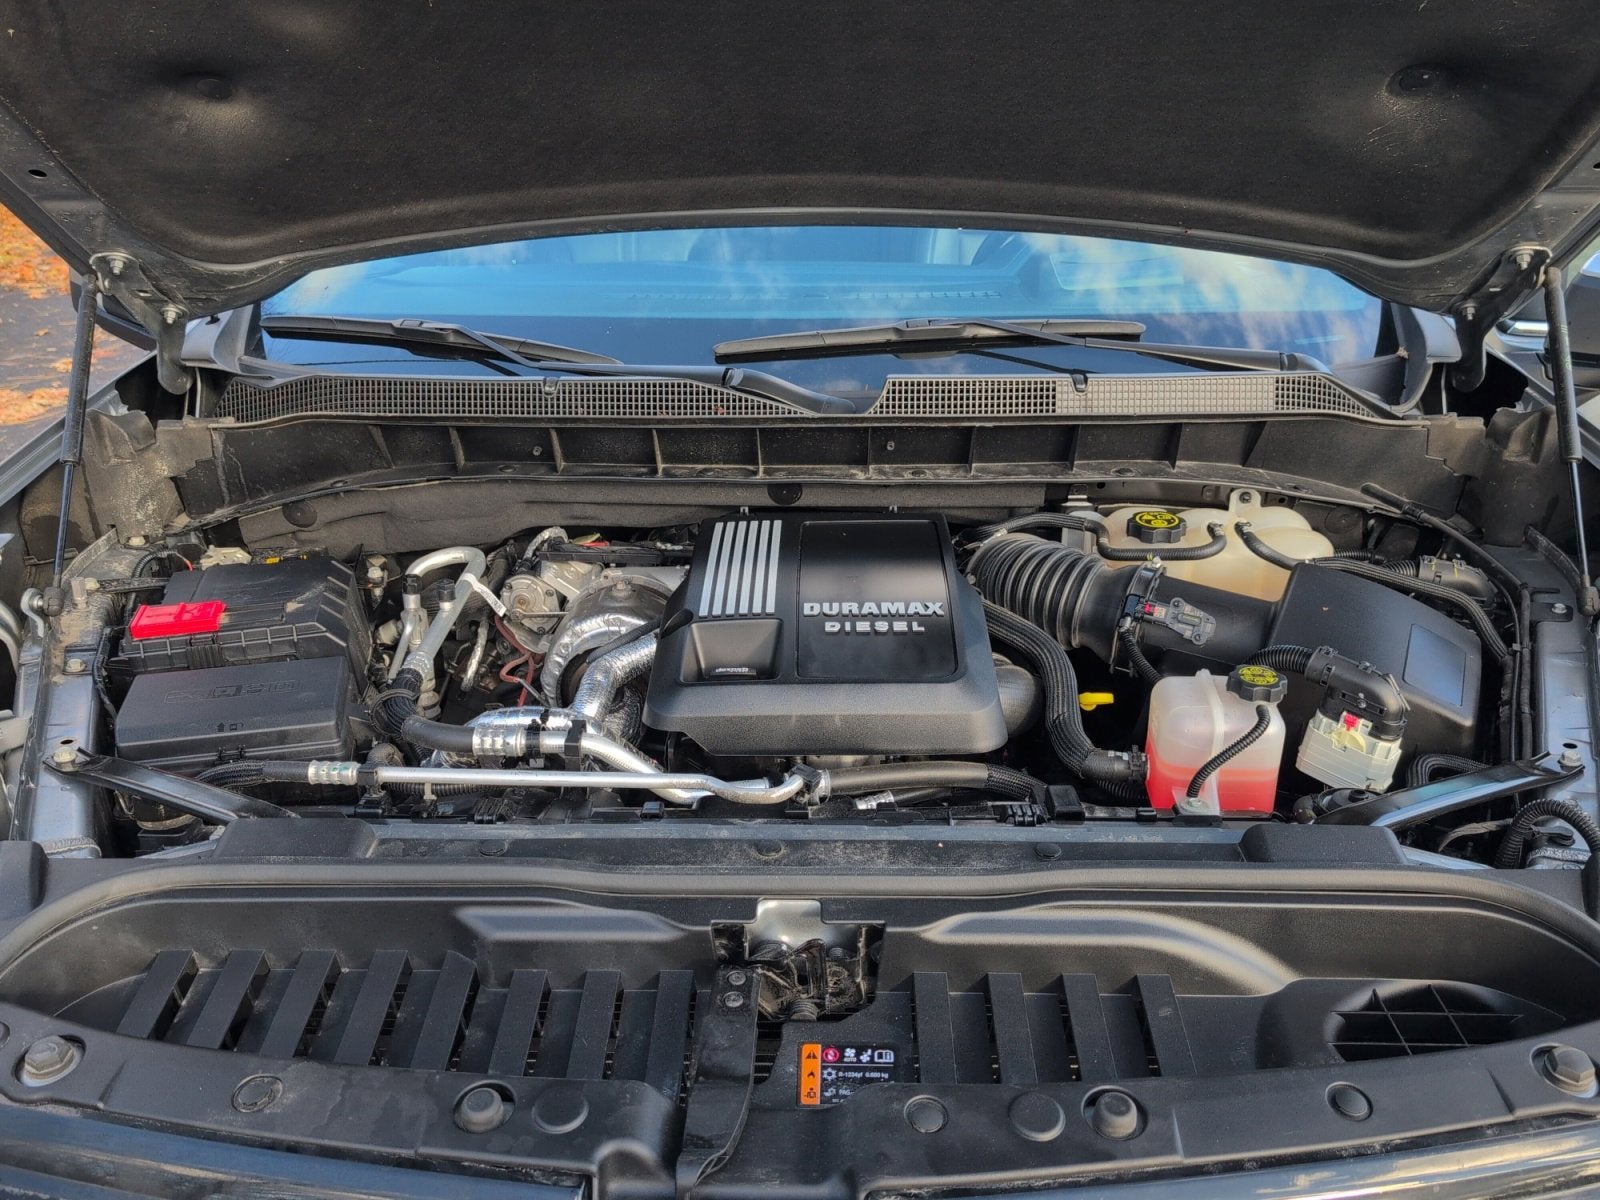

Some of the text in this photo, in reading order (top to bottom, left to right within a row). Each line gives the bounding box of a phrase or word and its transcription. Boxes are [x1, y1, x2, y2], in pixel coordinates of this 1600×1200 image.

[803, 601, 945, 617] DURAMAX
[824, 621, 926, 633] DIESEL
[881, 1071, 889, 1079] kg
